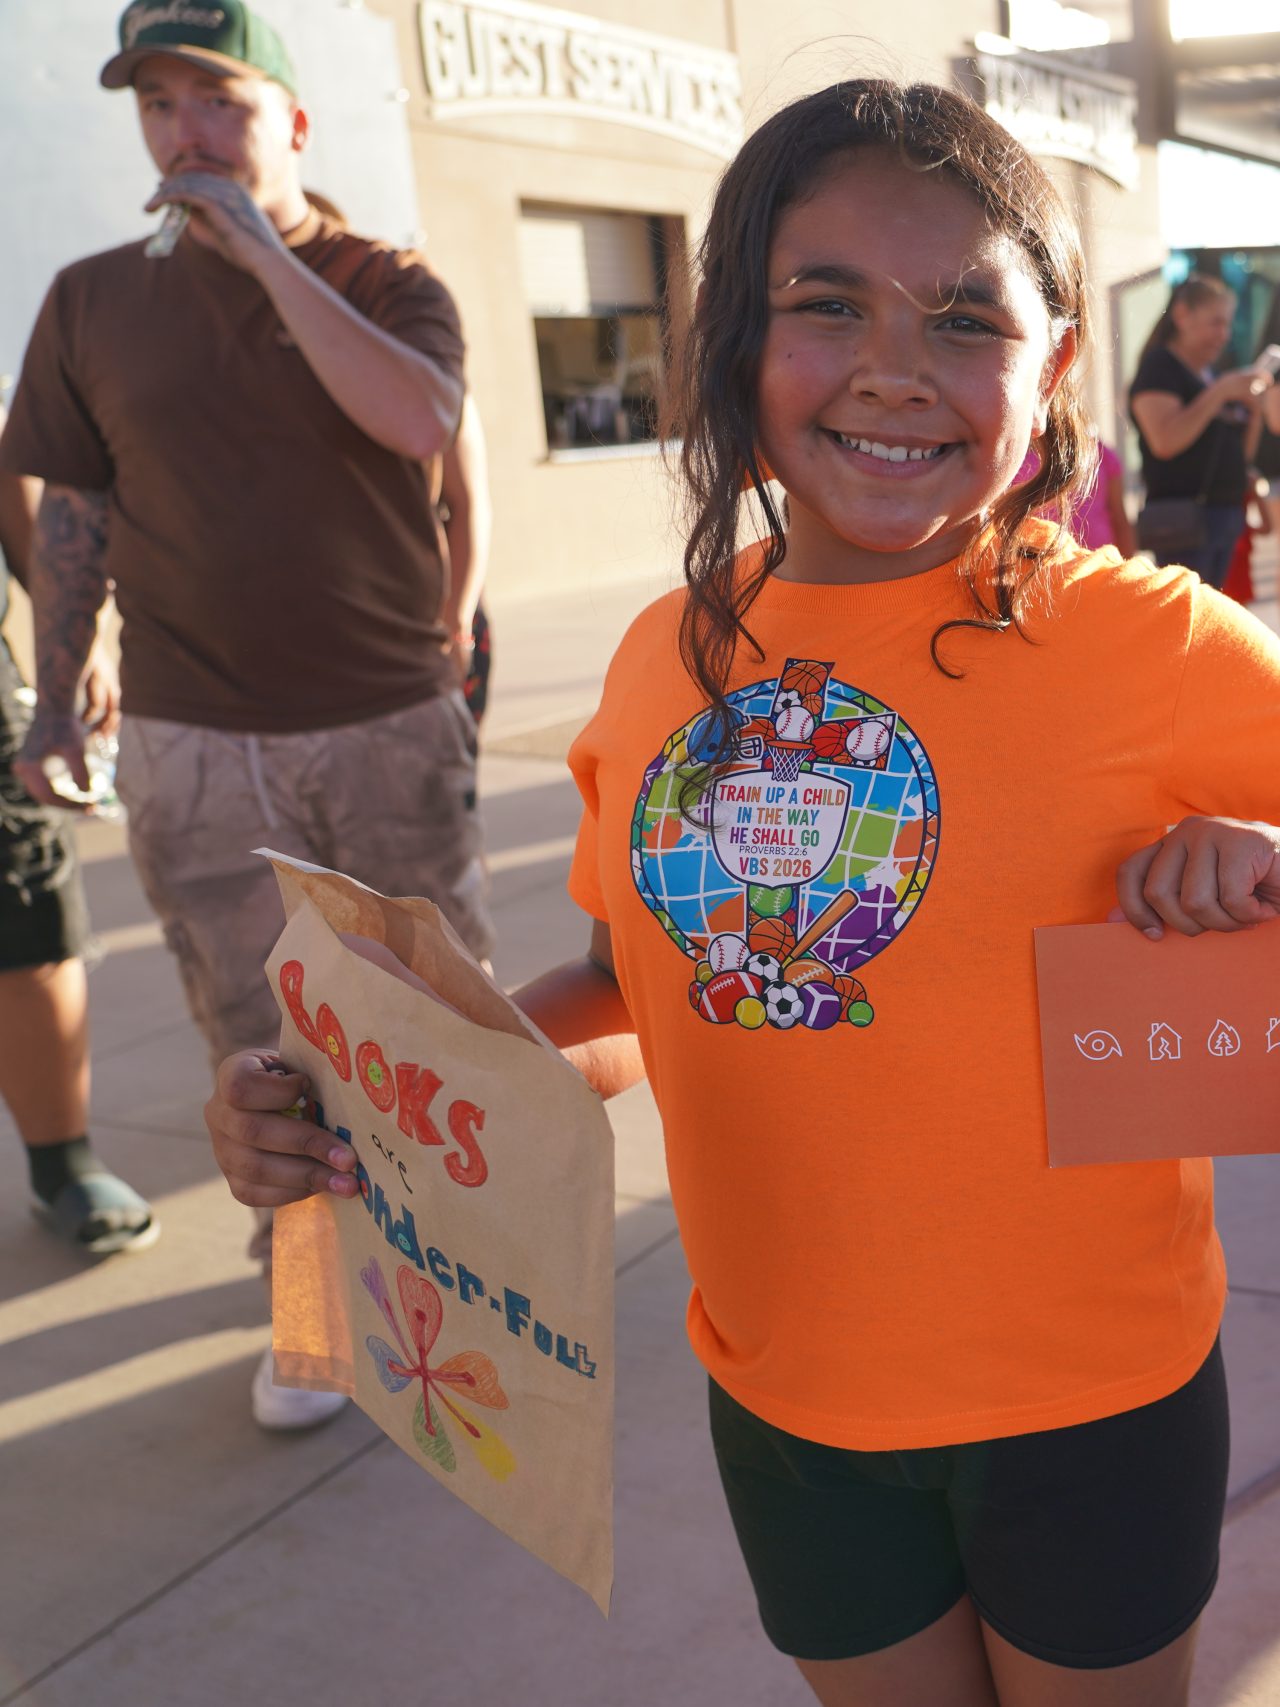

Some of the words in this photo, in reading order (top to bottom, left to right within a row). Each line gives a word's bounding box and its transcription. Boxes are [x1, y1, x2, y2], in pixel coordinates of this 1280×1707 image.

[421, 1, 568, 99] GUEST
[719, 784, 762, 803] TRAIN
[765, 786, 786, 805] UP
[788, 787, 798, 805] A
[803, 787, 846, 806] CHILD
[737, 806, 752, 824] IN
[757, 807, 784, 826] THE
[787, 808, 820, 826] WAY
[729, 826, 749, 844] HE
[751, 827, 796, 847] SHALL
[800, 829, 820, 847] GO
[739, 845, 787, 856] PROVERBS
[788, 847, 808, 857] 22:6
[739, 856, 769, 876] VBS
[772, 858, 812, 878] 2026
[371, 1133, 414, 1195] are
